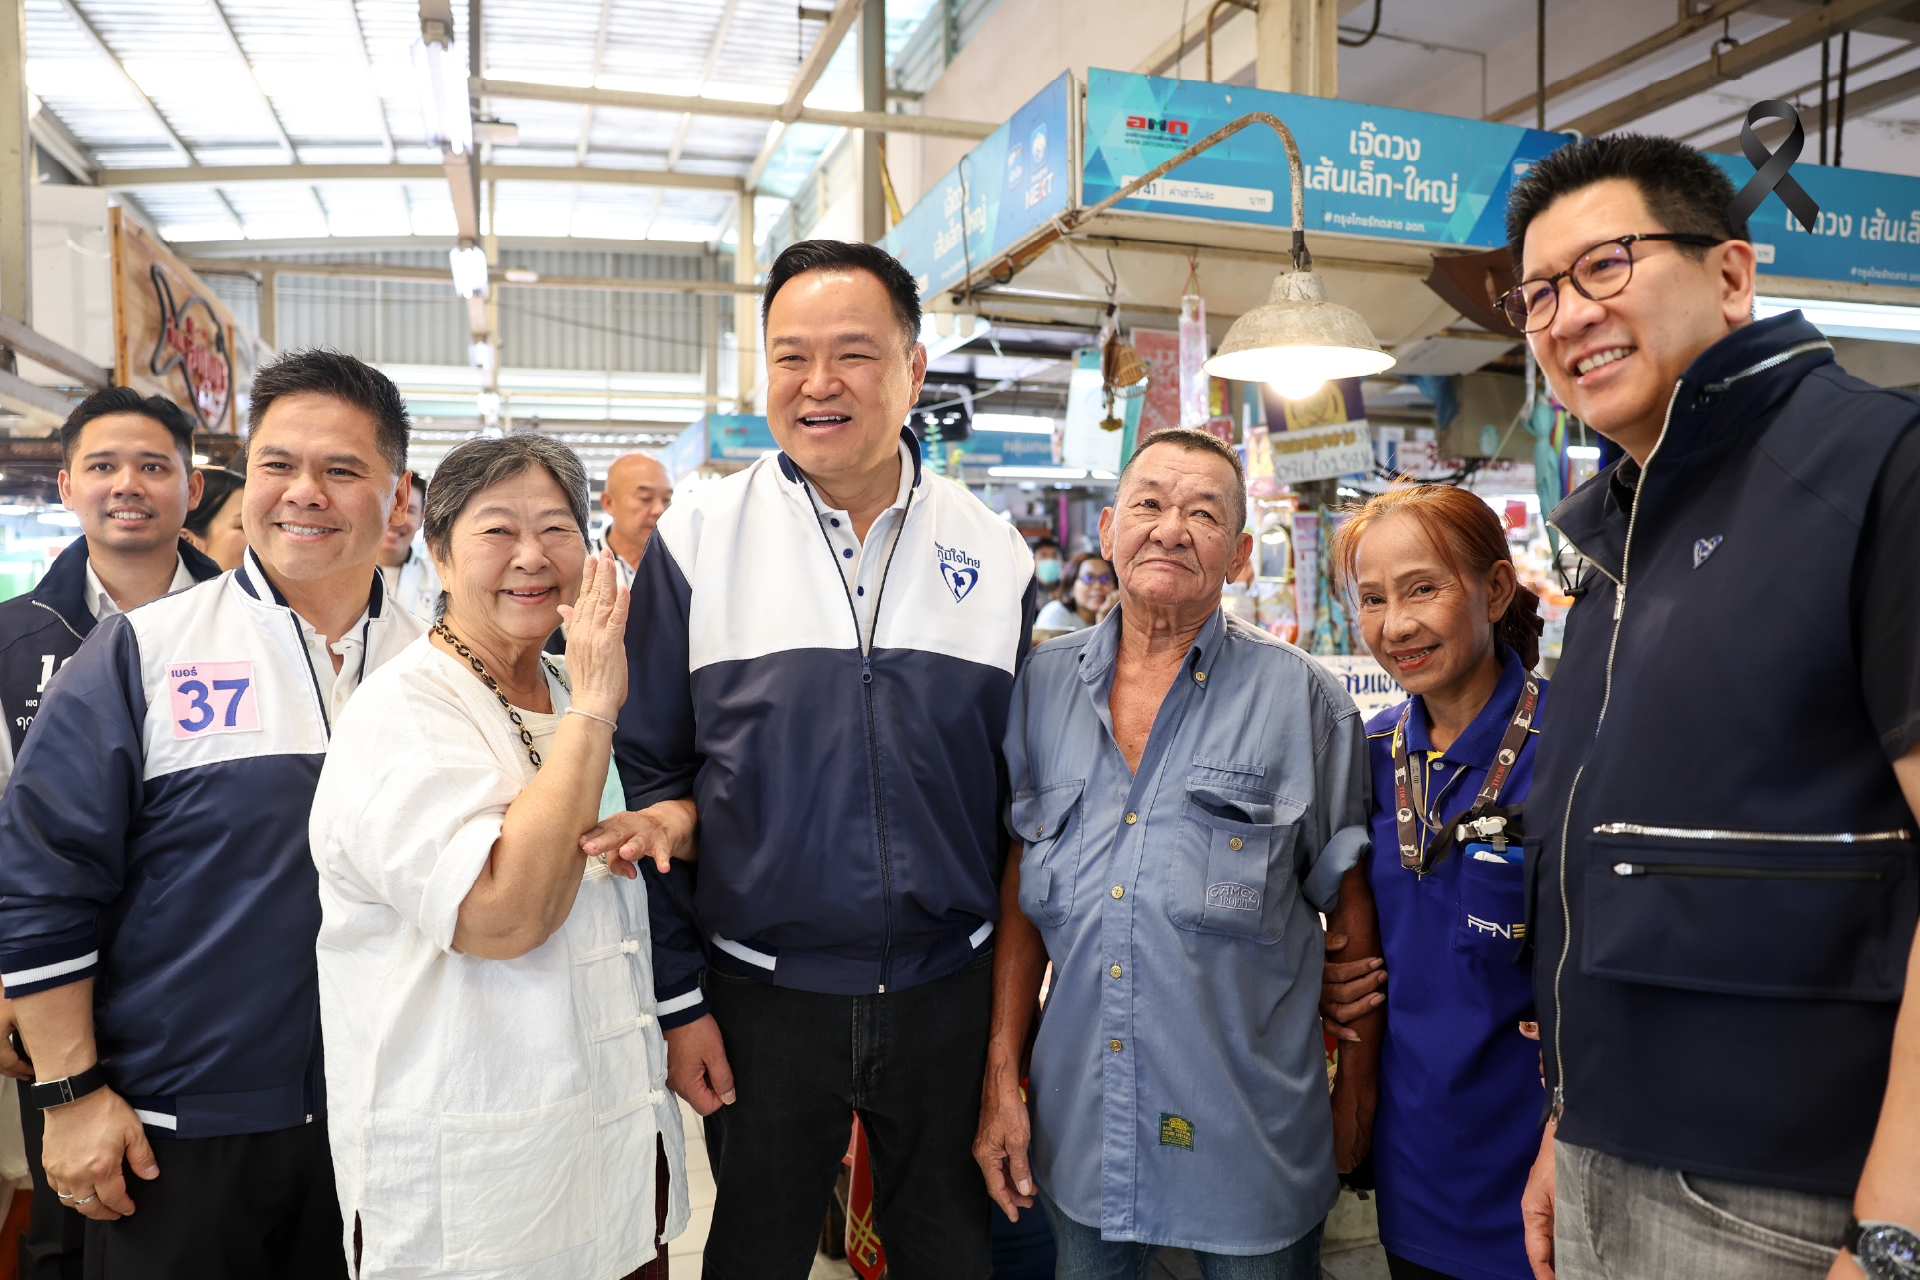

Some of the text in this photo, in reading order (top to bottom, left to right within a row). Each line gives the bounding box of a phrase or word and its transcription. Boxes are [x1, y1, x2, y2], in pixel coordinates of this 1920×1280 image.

[1350, 121, 1421, 161] เจ๊ดวง
[1025, 173, 1055, 210] NEXT
[1304, 156, 1458, 213] เส้นเล็ก-ใหญ่
[937, 548, 980, 569] ภูมิใจไทย
[36, 654, 73, 692] 1
[171, 666, 198, 678] เบอร์
[177, 678, 250, 732] 37
[1525, 694, 1535, 711] THOR
[1491, 765, 1506, 787] THOR
[1399, 786, 1407, 808] THOR
[1210, 885, 1257, 903] CAMEL
[1220, 895, 1249, 908] TROPHY
